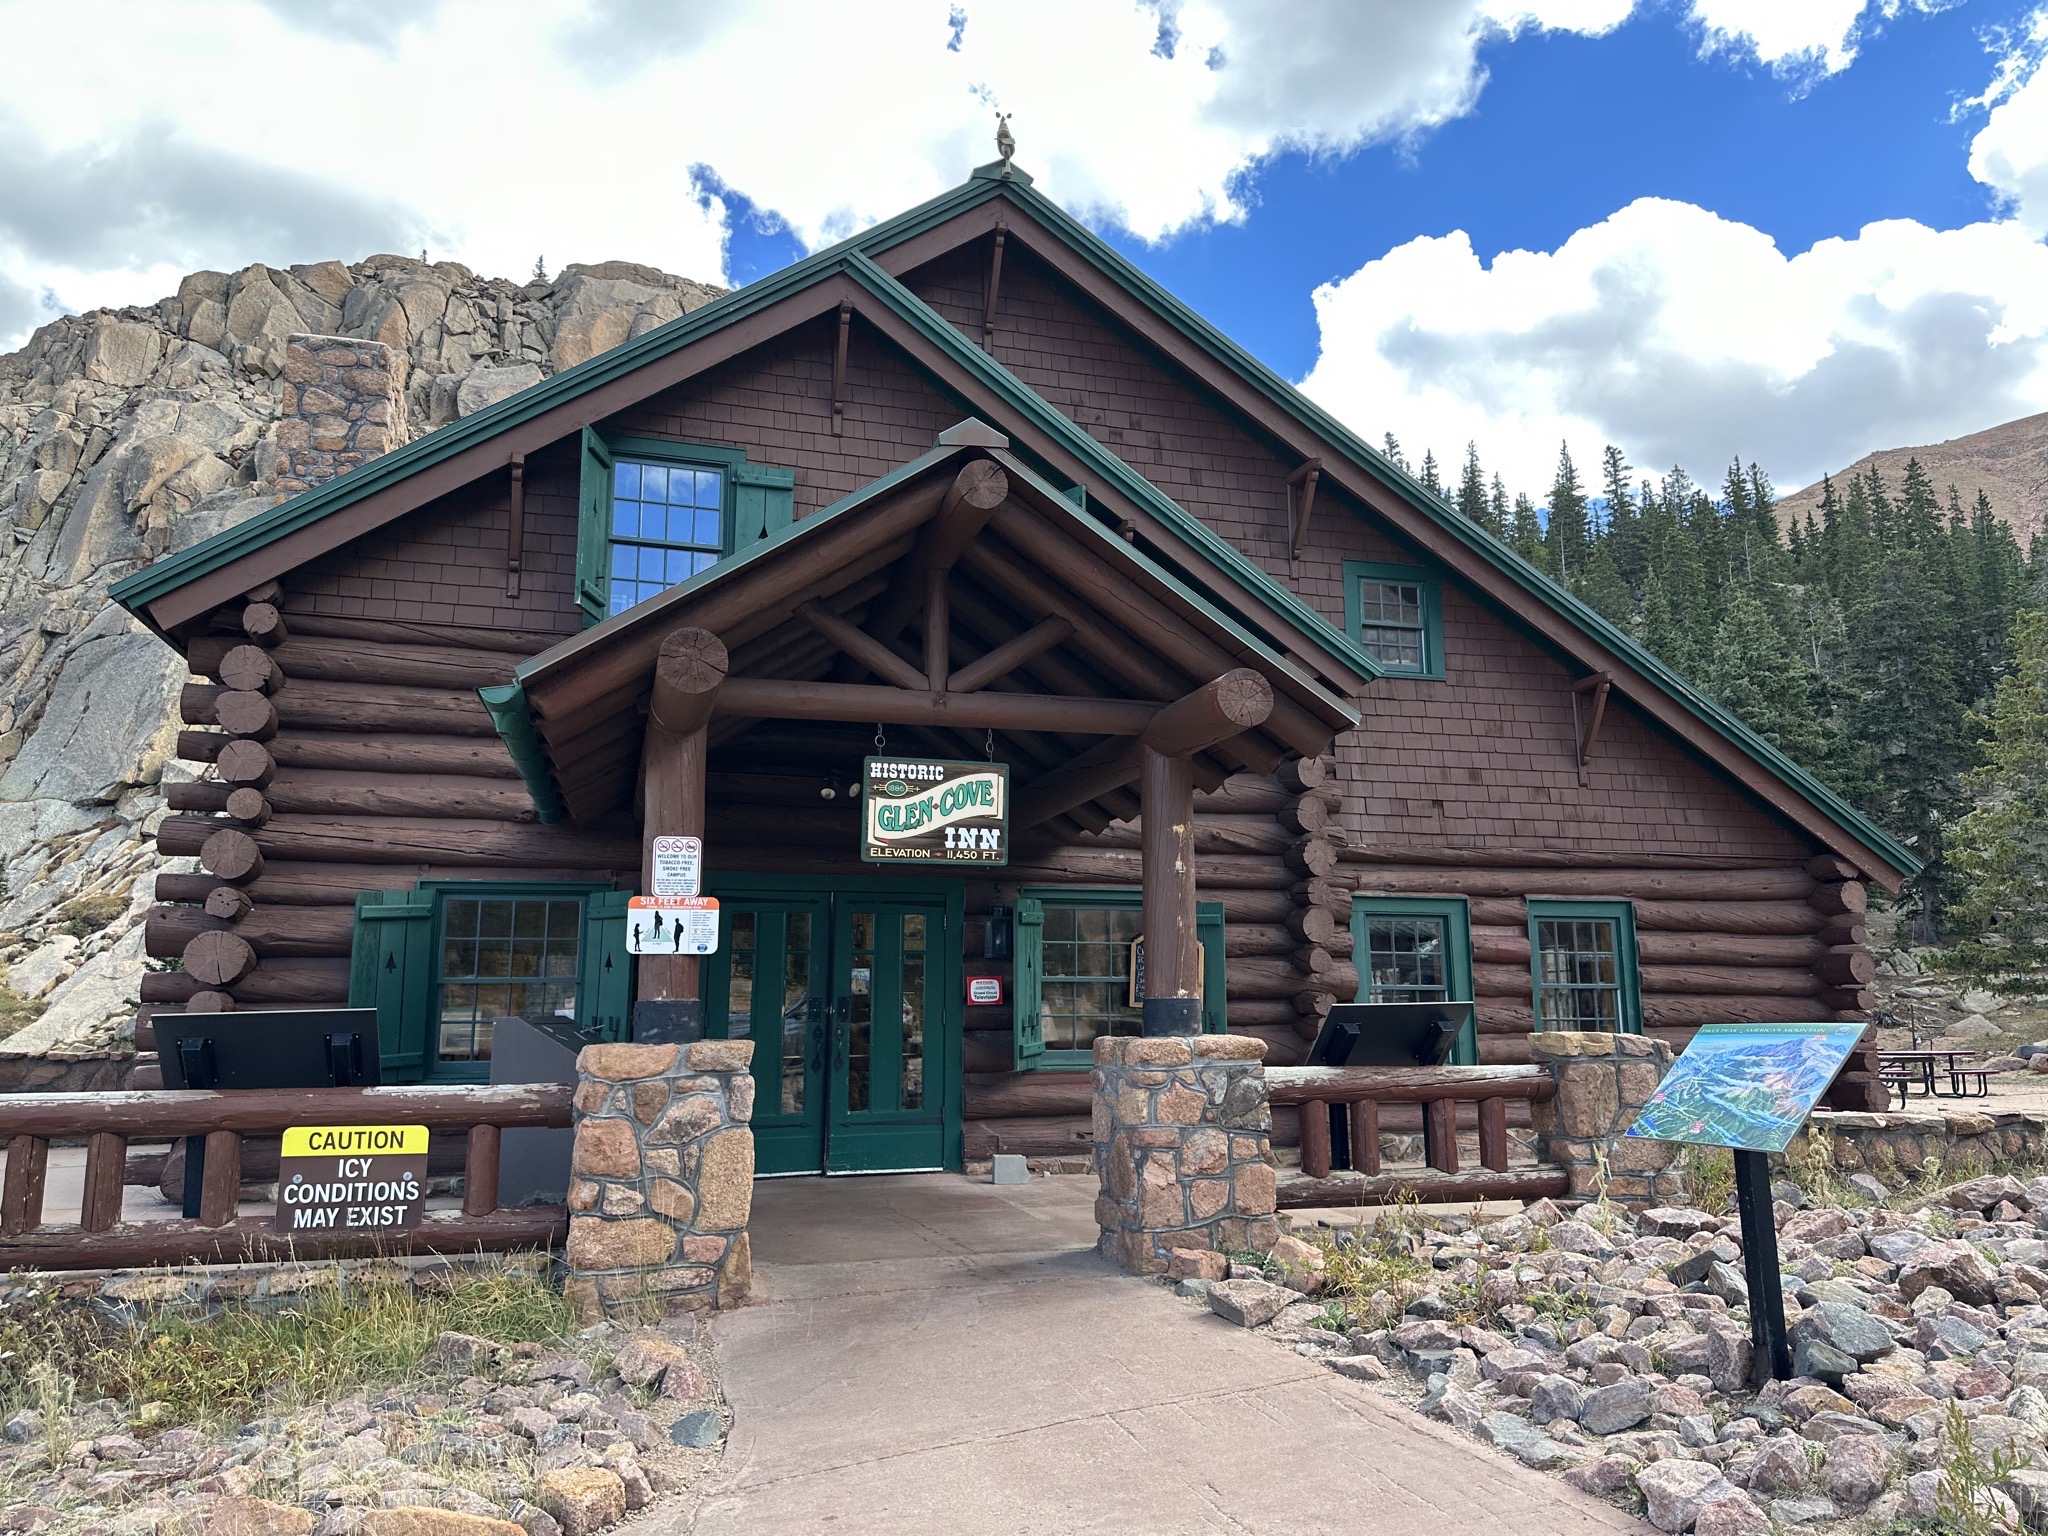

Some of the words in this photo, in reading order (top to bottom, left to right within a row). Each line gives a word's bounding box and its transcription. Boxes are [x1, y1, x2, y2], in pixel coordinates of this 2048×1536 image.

[870, 762, 944, 781] HISTORIC
[888, 784, 904, 792] 1886
[878, 796, 934, 832] GLEN
[940, 779, 995, 817] COVE
[944, 826, 1001, 850] INN
[870, 848, 931, 858] ELEVATION
[946, 850, 978, 860] 11,450
[982, 851, 1000, 860] FT.
[640, 896, 656, 905] SIX
[658, 897, 681, 905] FEET
[684, 897, 709, 906] AWAY
[308, 1130, 405, 1151] CAUTION
[338, 1158, 373, 1178] ICY
[283, 1180, 420, 1204] CONDITIONS
[293, 1207, 340, 1229] MAY
[346, 1205, 408, 1227] EXIST
